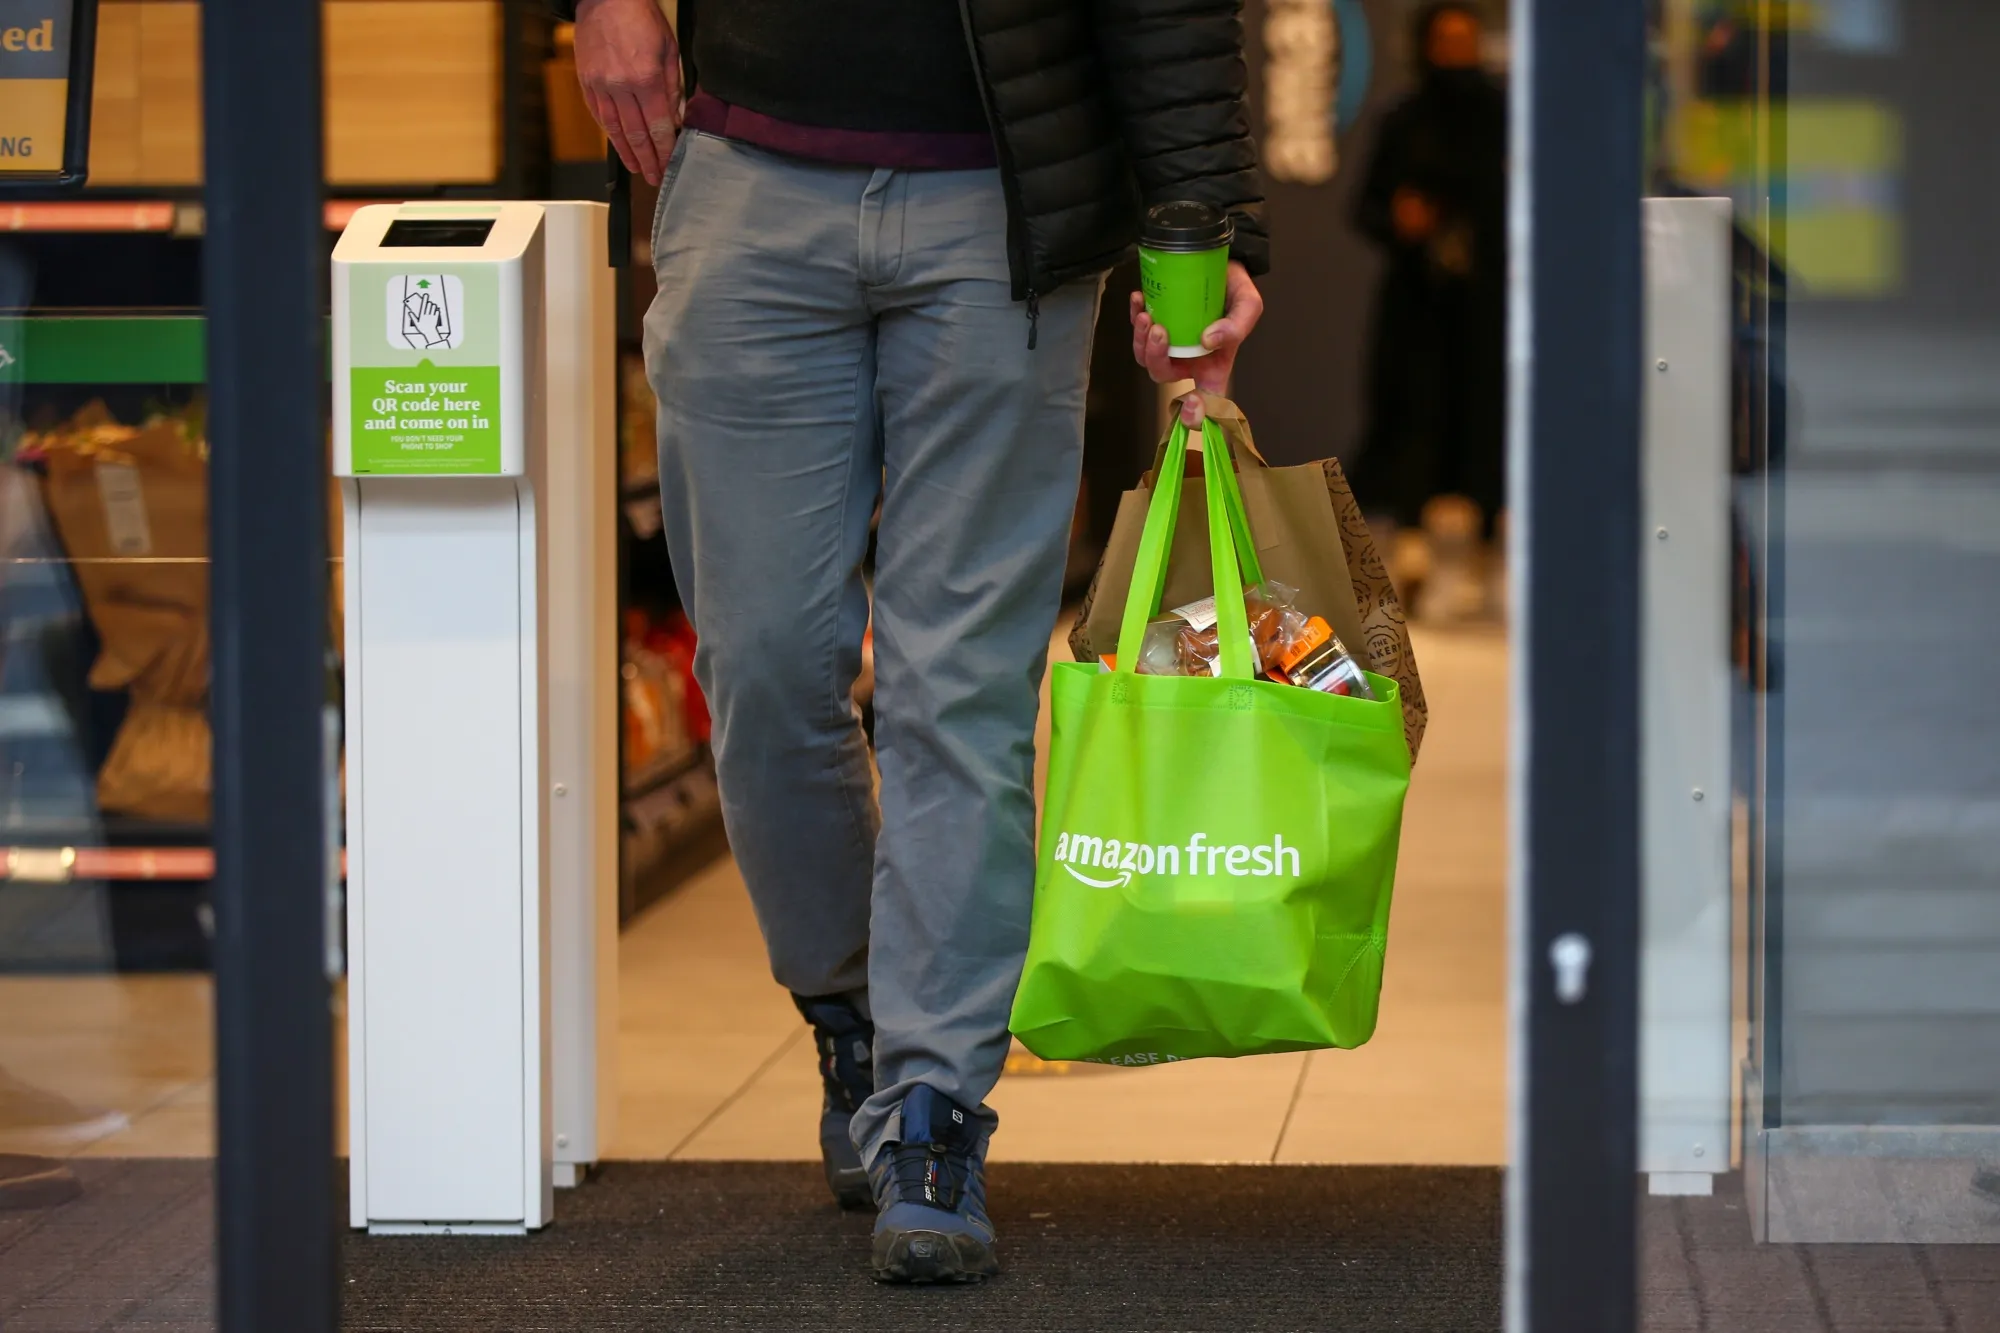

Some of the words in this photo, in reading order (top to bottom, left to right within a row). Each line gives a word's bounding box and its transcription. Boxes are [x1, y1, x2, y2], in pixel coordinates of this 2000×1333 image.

[0, 18, 54, 52] ed
[385, 380, 425, 394] Scan
[429, 382, 468, 396] your
[372, 398, 398, 415] QR
[401, 398, 440, 411] code
[444, 397, 480, 411] here
[364, 416, 396, 430] and
[400, 418, 443, 429] come
[447, 418, 468, 429] on
[472, 414, 489, 429] in
[446, 434, 464, 442] YOUR
[1372, 638, 1388, 648] THE
[1054, 831, 1180, 876] amazon
[1185, 832, 1300, 877] fresh
